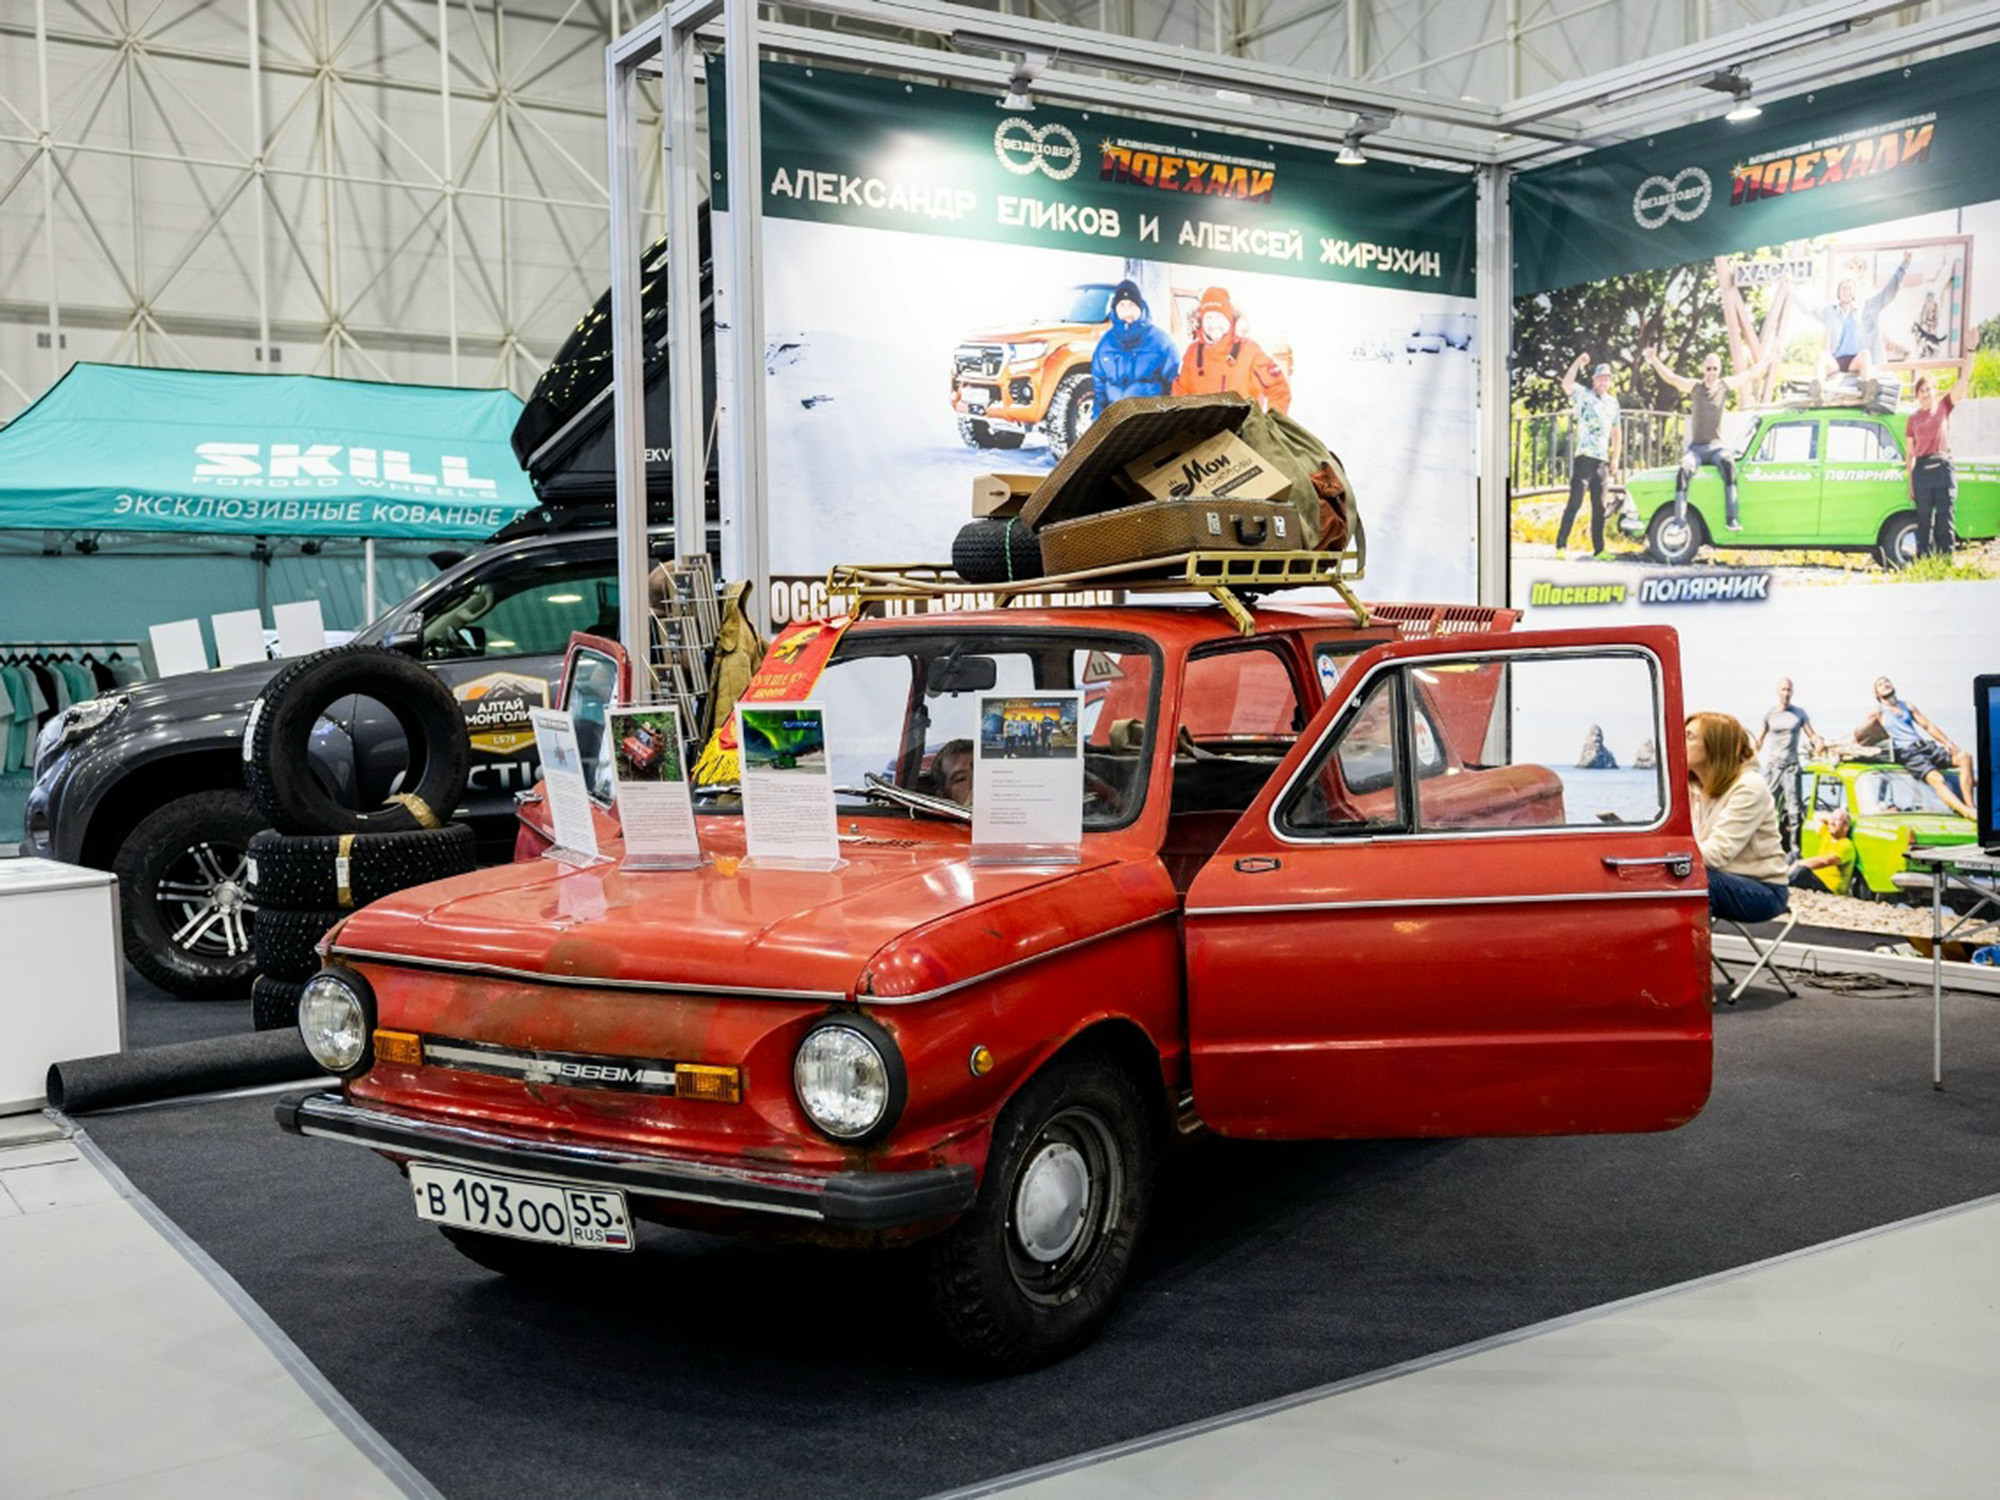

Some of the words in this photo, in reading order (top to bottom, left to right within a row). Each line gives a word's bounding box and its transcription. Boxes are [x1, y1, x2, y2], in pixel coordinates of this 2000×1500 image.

[1101, 147, 1275, 204] ПОЕХАЛИ
[1730, 124, 1934, 206] ПОЕХАЛИ
[771, 168, 977, 221] АЛЕКСАНДР
[997, 195, 1121, 238] ЕЛИКОВ
[1139, 214, 1159, 243] И
[1179, 220, 1303, 261] АЛЕКСЕЙ
[1320, 238, 1440, 277] ЖИРУХИН
[1737, 261, 1812, 282] ХАСАН
[194, 442, 496, 489] SKILL
[1825, 469, 1904, 482] ПОЛЯРНИК
[192, 476, 340, 488] FORGED
[356, 479, 499, 499] WHEELS
[113, 495, 362, 522] ЭКСКЛЮЗИВНЫЕ
[372, 504, 502, 527] КОВАНЫЕ
[1531, 583, 1626, 605] Москвич
[1641, 574, 1769, 602] ПОЛЯРНИК
[465, 710, 532, 725] МОНГОЛИ
[477, 698, 524, 713] АЛТАЙ
[572, 1194, 612, 1228] 55
[575, 1227, 604, 1242] RUS
